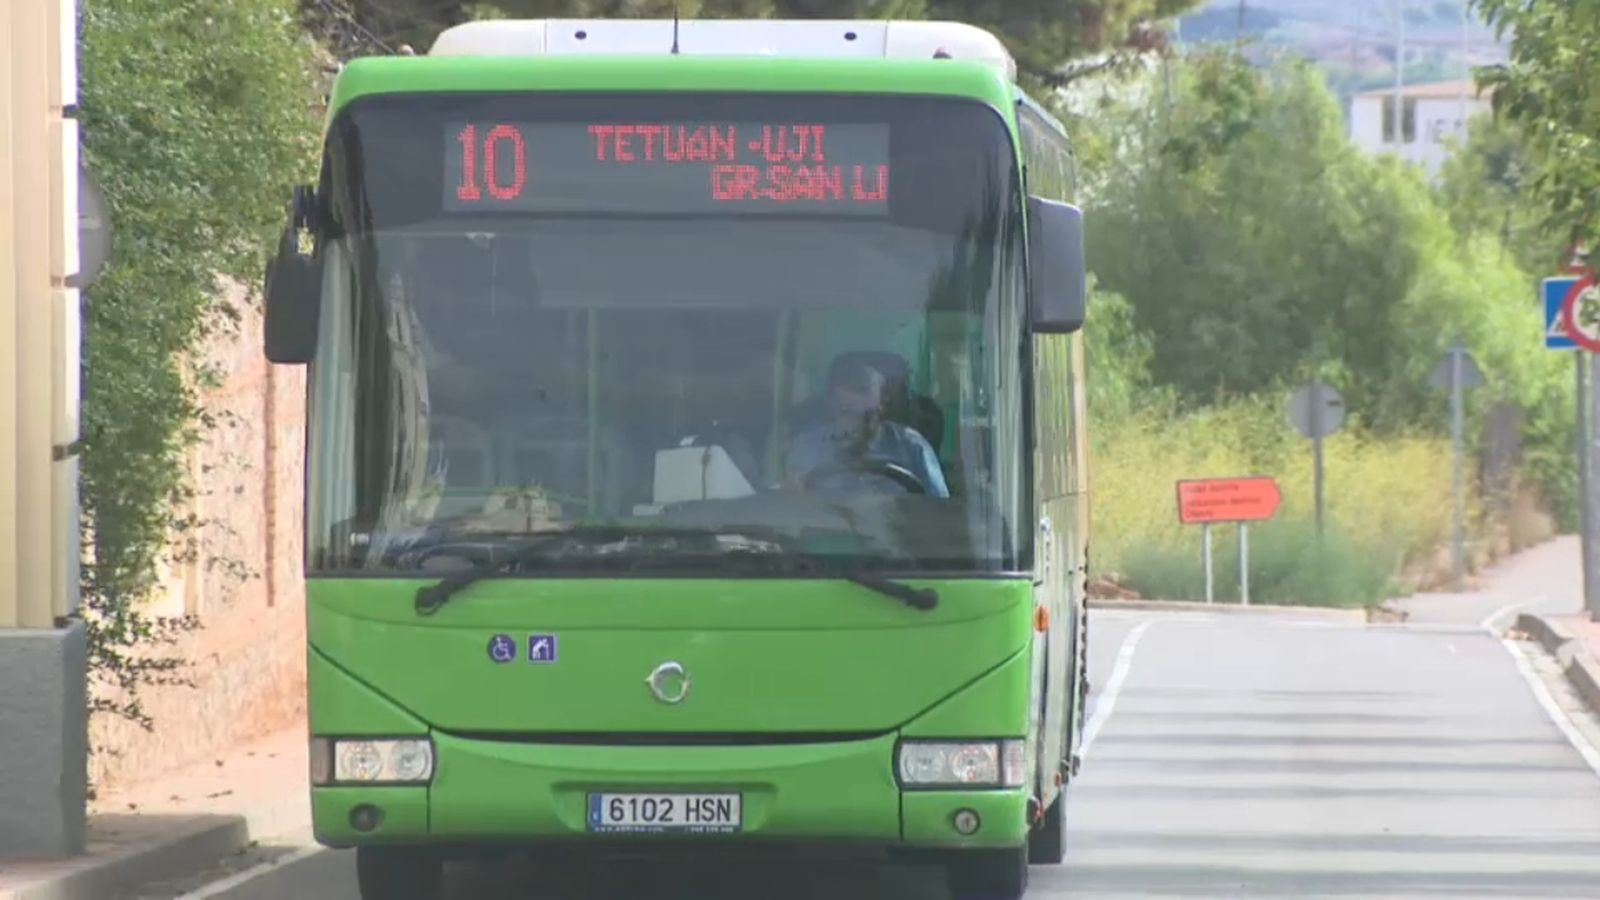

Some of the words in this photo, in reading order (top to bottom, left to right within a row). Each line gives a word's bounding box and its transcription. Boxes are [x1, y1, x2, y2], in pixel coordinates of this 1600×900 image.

[459, 124, 526, 200] 10
[609, 798, 674, 822] 6102
[686, 798, 731, 822] HSN
